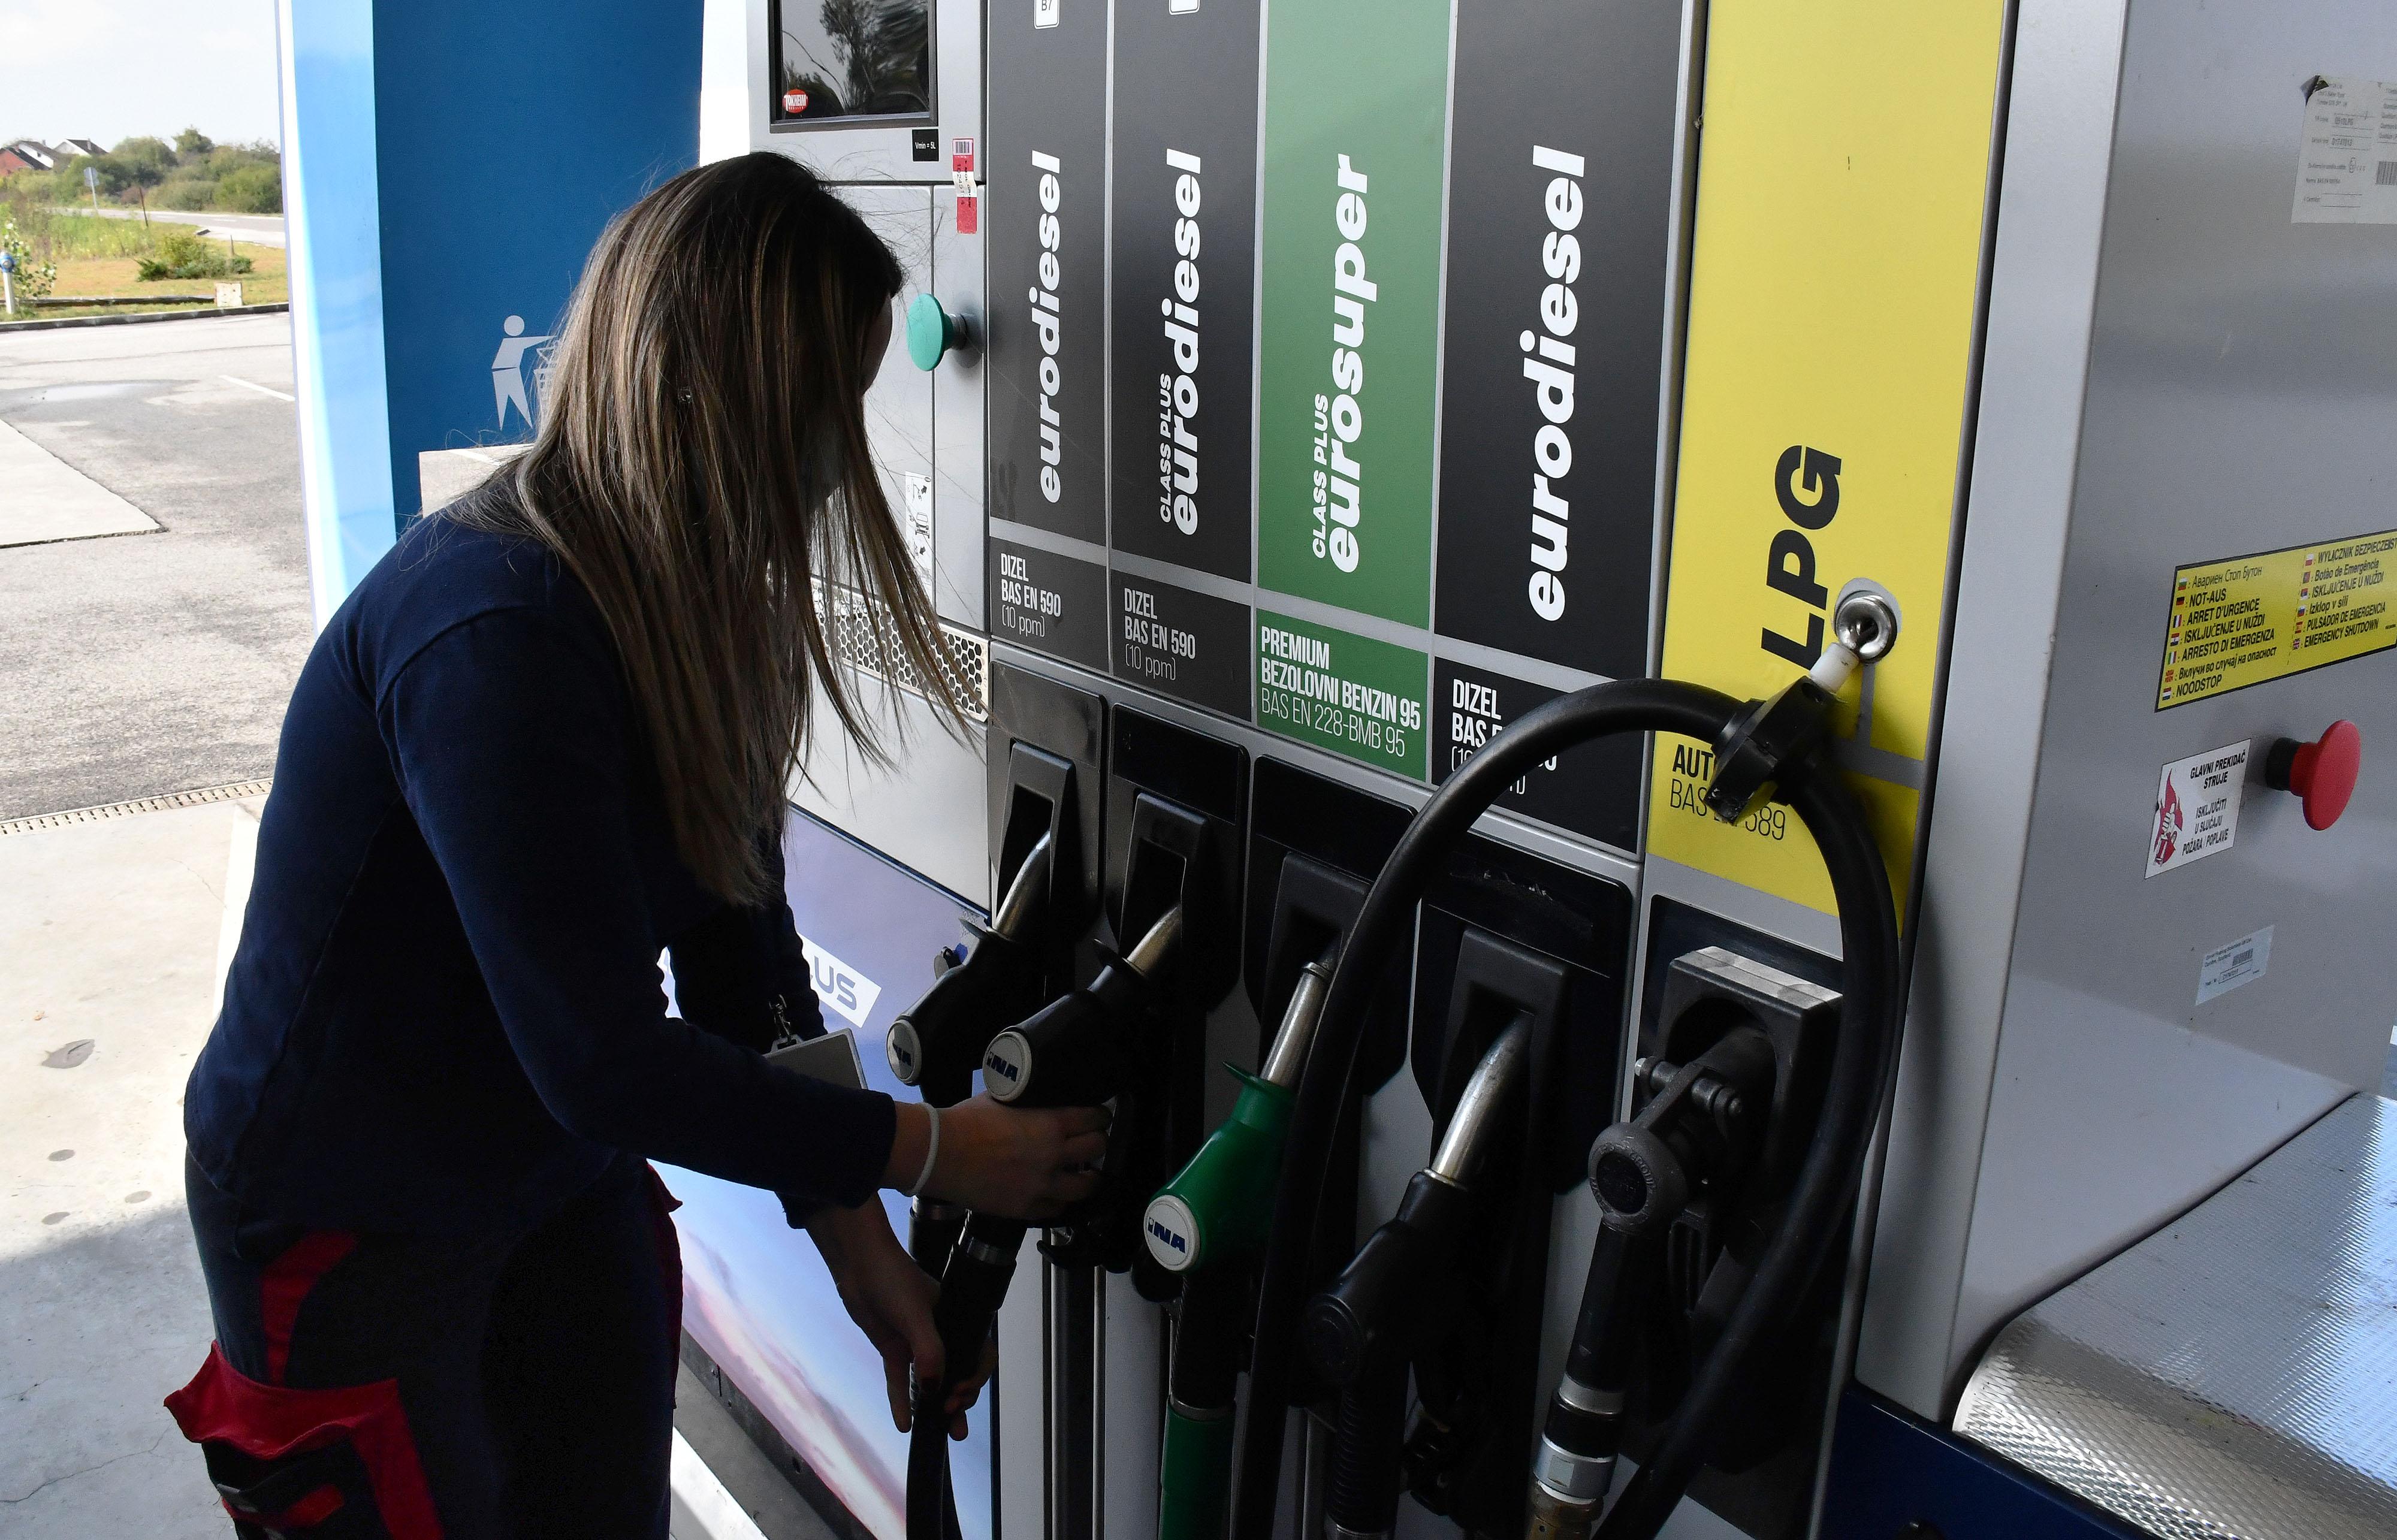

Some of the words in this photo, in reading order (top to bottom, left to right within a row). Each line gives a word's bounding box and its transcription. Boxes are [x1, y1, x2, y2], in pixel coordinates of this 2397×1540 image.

[1031, 150, 1061, 503] eurodiesel
[1161, 148, 1201, 535] eurodiesel
[1329, 153, 1377, 573] eurosuper
[1519, 145, 1585, 621] eurodiesel
[1160, 374, 1172, 439] PLUS
[1314, 394, 1329, 466] PLUS
[1160, 443, 1172, 523] CLASS
[1312, 470, 1327, 558] CLASS
[1001, 553, 1029, 582] DIZEL
[1761, 445, 1842, 671] LPG
[2224, 569, 2241, 582] Стоп
[2242, 566, 2263, 581] Бутон
[2335, 566, 2342, 578] de
[1001, 579, 1022, 606] BAS
[1024, 585, 1037, 611] EN
[1040, 590, 1061, 617] 590
[2189, 588, 2227, 608] NOT-AUS
[2358, 576, 2363, 588] U
[1002, 605, 1016, 629] (10
[1019, 615, 1045, 638] ppm)
[1124, 588, 1157, 620] DIZEL
[2187, 608, 2215, 626] ARRET
[2215, 598, 2260, 619] D'URGENCE
[2236, 620, 2242, 632] U
[2243, 612, 2266, 630] NUŽDI
[2307, 613, 2340, 632] PULSADOR
[2340, 611, 2348, 624] DE
[2309, 601, 2331, 615] Izklop
[2332, 598, 2337, 609] v
[1125, 615, 1148, 645] BAS
[1152, 623, 1167, 651] EN
[1172, 630, 1196, 659] 590
[1261, 626, 1329, 670] PREMIUM
[2181, 644, 2219, 662] ARRESTO
[2220, 639, 2229, 653] DI
[2230, 628, 2275, 650] EMERGENZA
[2304, 627, 2344, 648] EMERGENCY
[2344, 618, 2380, 637] SHUTDOWN
[1125, 644, 1142, 670] (10
[1146, 657, 1176, 681] ppm)
[1261, 657, 1339, 705] BEZOLOVNI
[1342, 681, 1397, 723] BENZIN
[1400, 698, 1421, 730] 95
[1452, 678, 1502, 720] DIZEL
[2176, 674, 2223, 697] NOODSTOP
[1261, 687, 1289, 719] BAS
[1293, 697, 1311, 727] EN
[1315, 703, 1381, 749] 228-BMB
[1385, 726, 1405, 757] 95
[1451, 711, 1487, 748] BAS
[2190, 762, 2214, 779] GLAVNI
[2203, 771, 2229, 789] STRUJE
[1670, 778, 1708, 817] BAS
[2194, 823, 2200, 834] U
[2206, 828, 2229, 847] POPLAVE
[810, 955, 858, 1011] US
